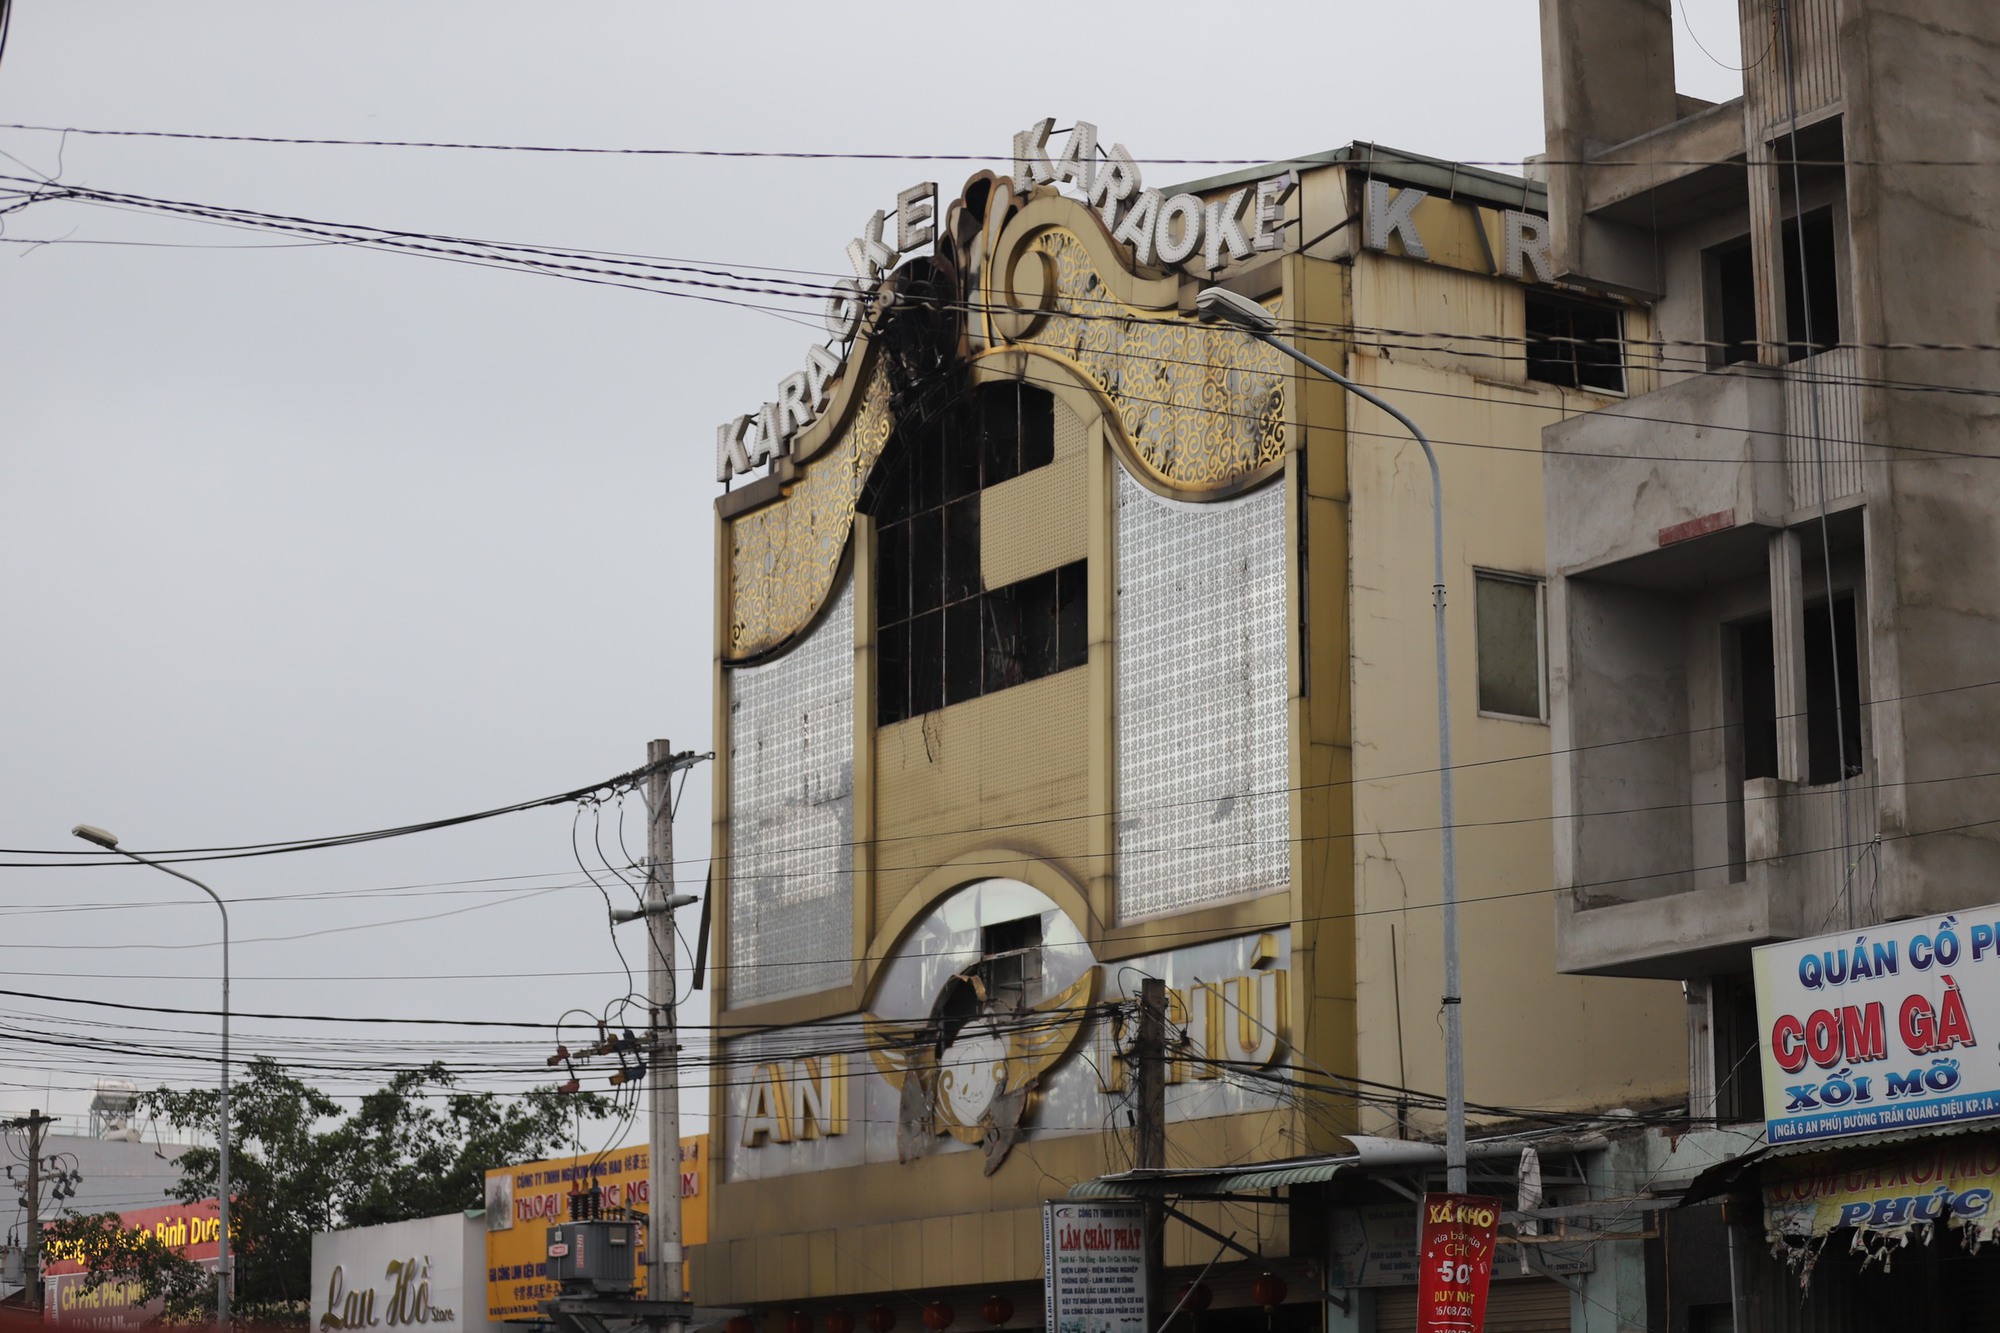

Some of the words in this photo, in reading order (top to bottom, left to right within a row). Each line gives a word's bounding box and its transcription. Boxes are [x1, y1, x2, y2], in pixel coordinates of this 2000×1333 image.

[1013, 117, 1298, 271] KARAOKE
[717, 181, 937, 482] KARAOKE
[1799, 936, 1898, 990] QUÁN
[1909, 916, 1960, 970] CỒ
[1971, 922, 2000, 959] P
[1771, 1001, 1888, 1074] CƠM
[1898, 974, 1976, 1055] GÀ
[741, 1053, 847, 1147] AN
[1785, 1067, 1872, 1111] XỐI
[1885, 1057, 1960, 1098] MỠ
[1774, 1122, 1797, 1139] (NGÃ
[1797, 1123, 1804, 1135] 6
[1805, 1120, 1818, 1133] AN
[1819, 1114, 1842, 1132] PHÚ)
[1843, 1111, 1877, 1129] ĐƯỜNG
[1879, 1105, 1905, 1124] TRẦN
[1906, 1105, 1939, 1121] QUANG
[1941, 1101, 1963, 1119] DIỆU
[1965, 1097, 1994, 1112] KP.1A
[535, 1174, 542, 1185] TY
[543, 1169, 560, 1185] TNHH
[515, 1193, 561, 1224] THOẠI
[1078, 1207, 1092, 1218] CÔNG
[1093, 1209, 1099, 1218] TY
[1100, 1209, 1113, 1218] TNHH
[1428, 1200, 1453, 1224] XẢ
[1456, 1204, 1495, 1228] KHO
[156, 1216, 188, 1248] Bình
[1060, 1223, 1081, 1251] LÂM
[1083, 1222, 1111, 1251] CHÂU
[1114, 1222, 1141, 1251] PHÁT
[1433, 1233, 1448, 1245] vừa
[62, 1279, 76, 1311] CÀ
[320, 1265, 379, 1333] Lan
[386, 1255, 431, 1327] Hồ
[1109, 1286, 1120, 1294] MÁY
[1121, 1287, 1135, 1295] LẠNH
[1434, 1290, 1454, 1303] DUY
[430, 1306, 455, 1322] Store
